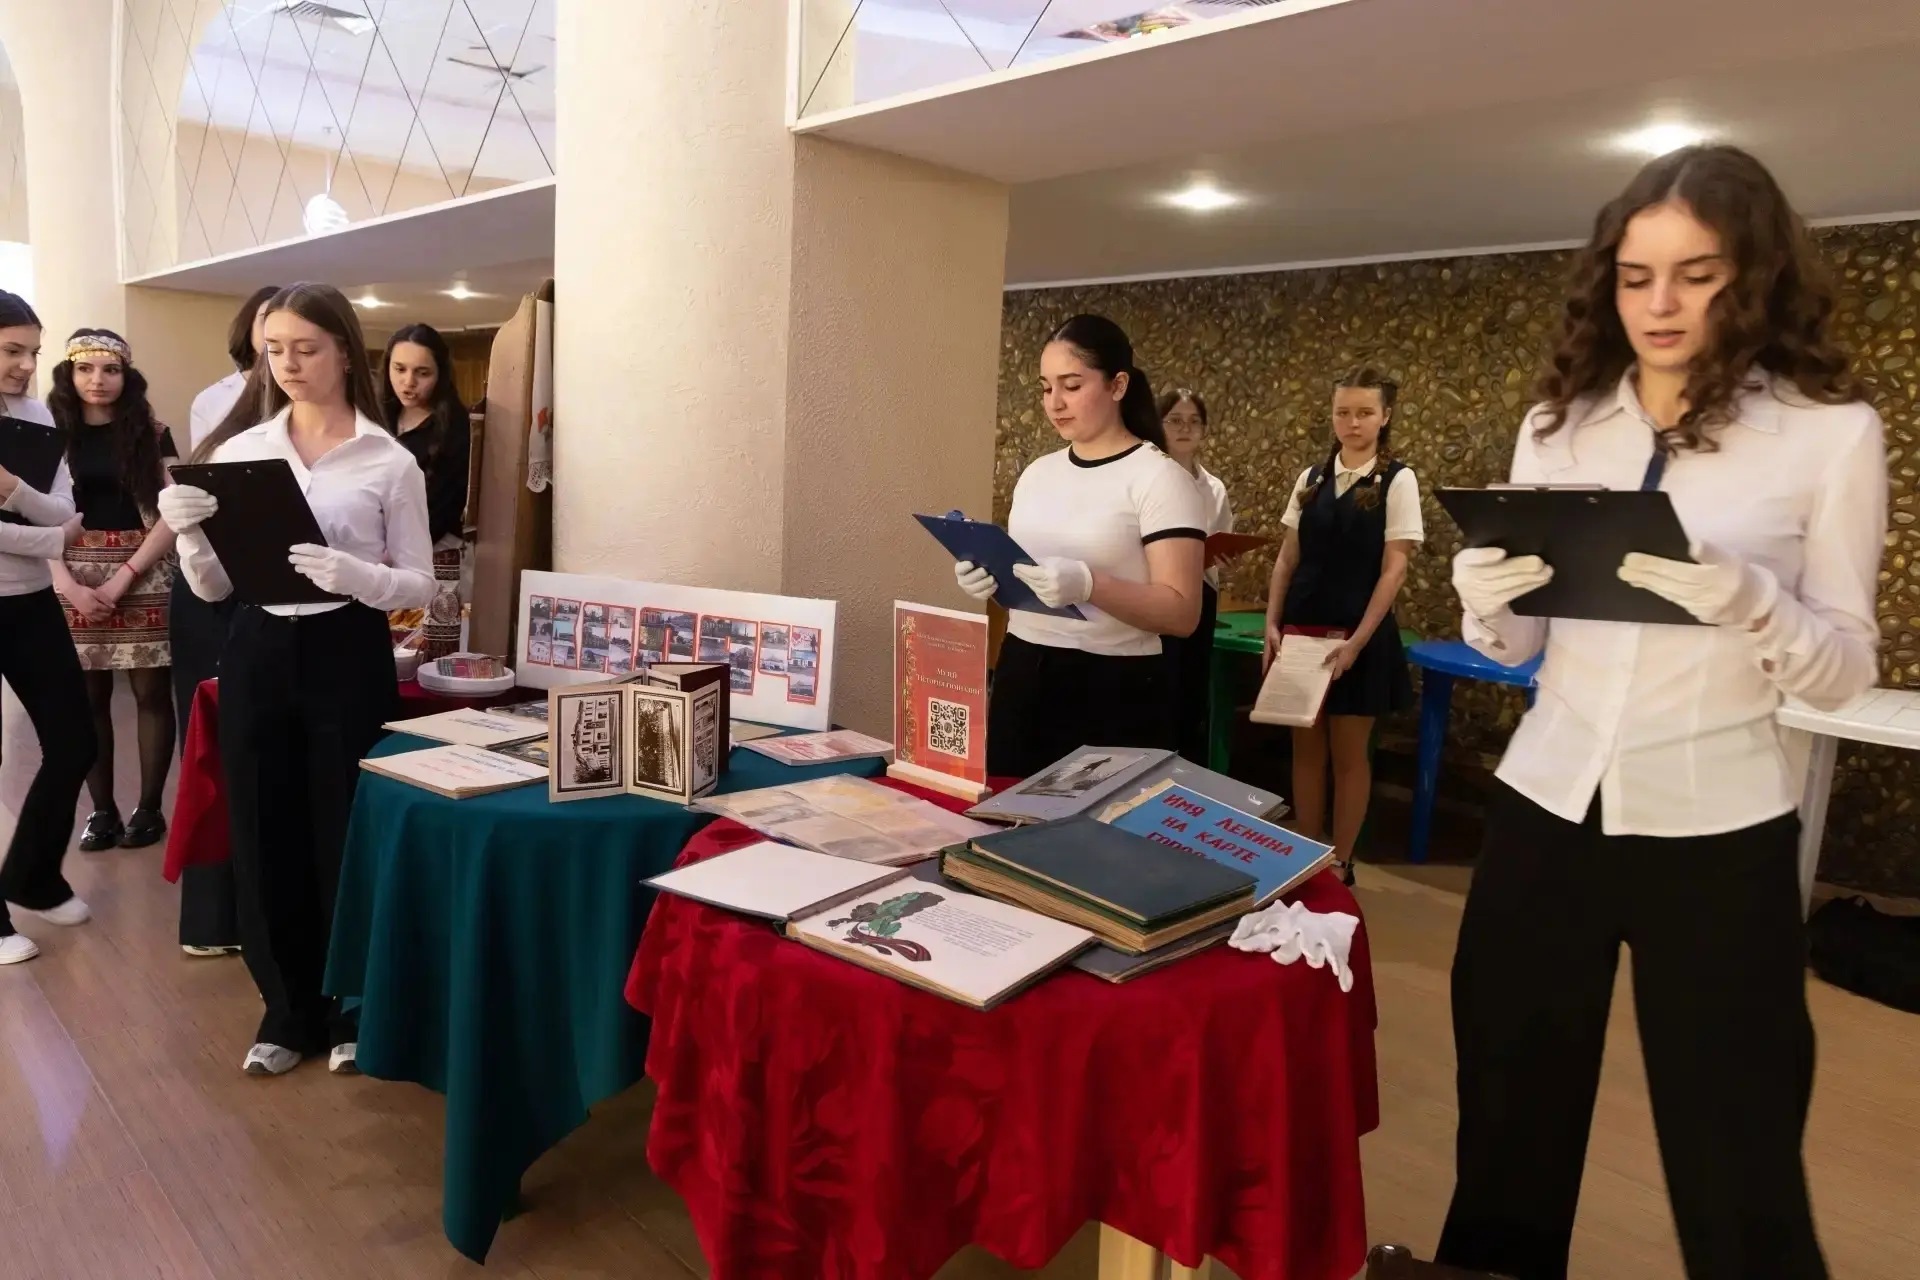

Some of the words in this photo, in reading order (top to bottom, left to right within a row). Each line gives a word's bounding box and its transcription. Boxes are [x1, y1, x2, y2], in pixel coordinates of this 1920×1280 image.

[1161, 816, 1189, 833] НА
[1194, 831, 1261, 864] КАРТЕ
[1162, 793, 1206, 818] ИМЯ
[1213, 817, 1294, 857] ЛЕНИНА
